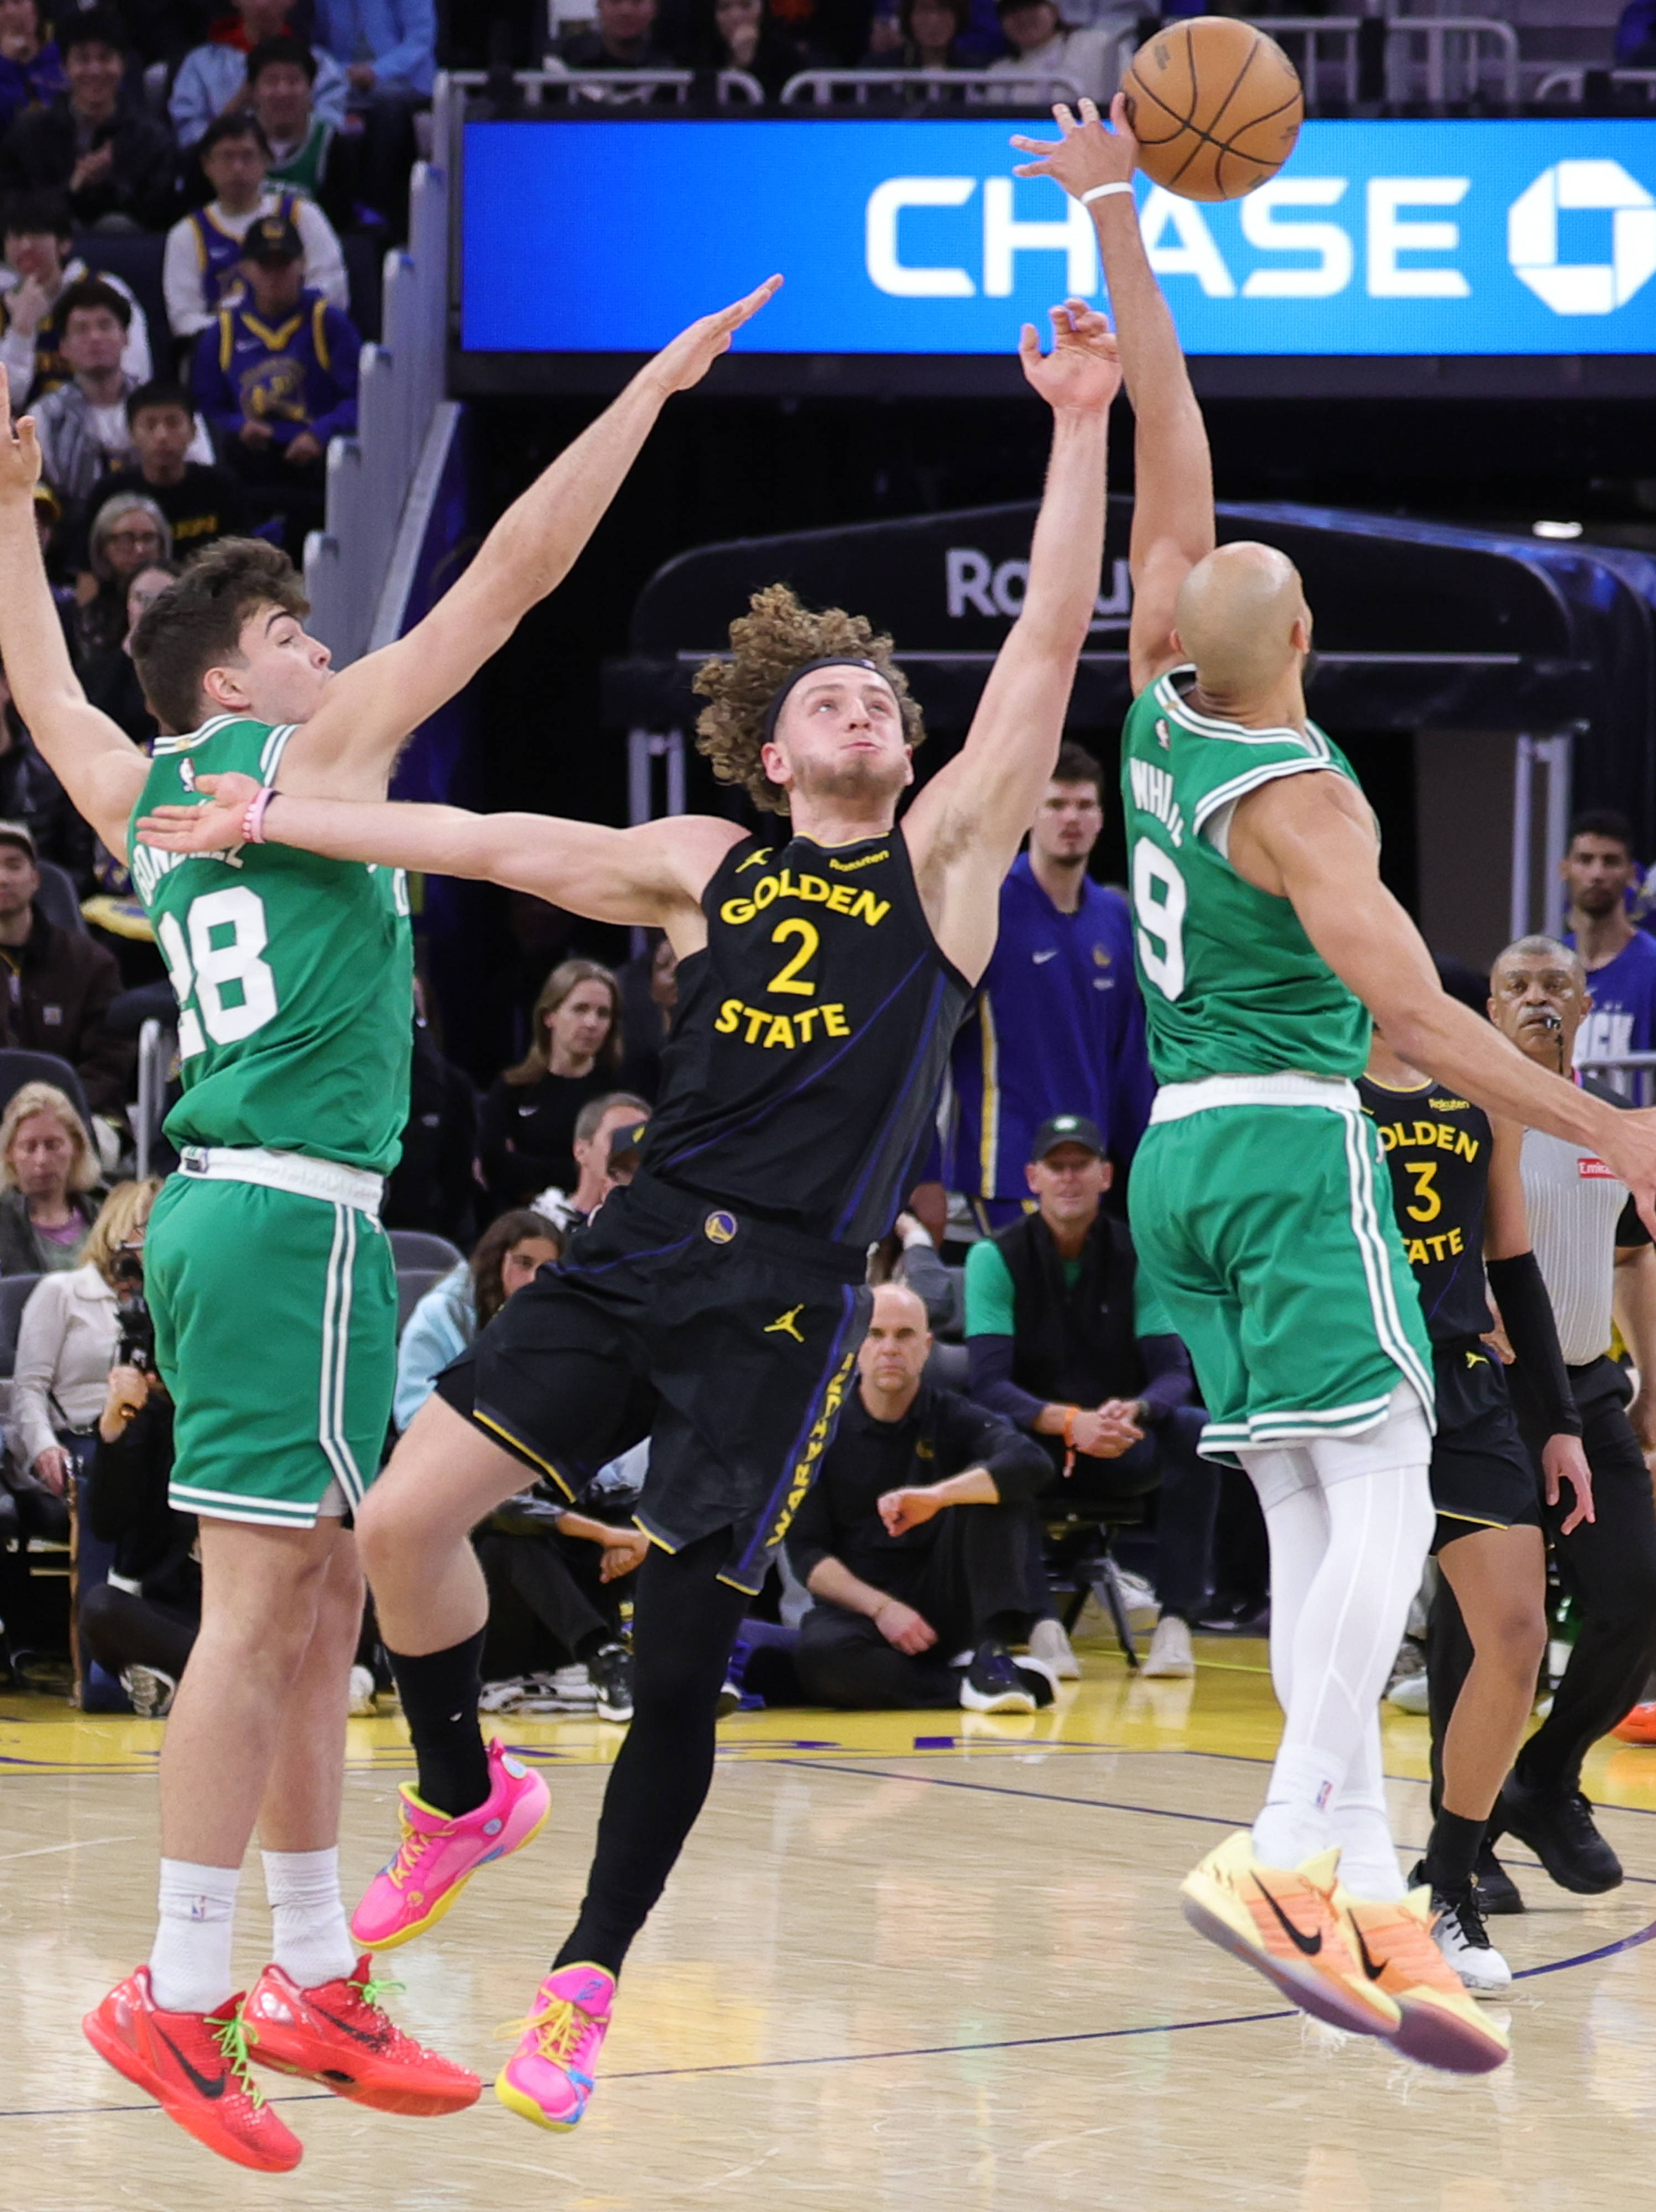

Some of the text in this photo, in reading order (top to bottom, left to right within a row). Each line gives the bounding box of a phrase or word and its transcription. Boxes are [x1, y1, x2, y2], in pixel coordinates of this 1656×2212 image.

[867, 177, 1471, 298] CHASE
[720, 869, 892, 926] GOLDEN
[1133, 836, 1187, 1002] 9
[157, 886, 279, 1061] 28
[767, 918, 820, 996] 2
[714, 999, 851, 1049] STATE
[1377, 1121, 1479, 1163] OLDEN
[1404, 1162, 1441, 1223] 3
